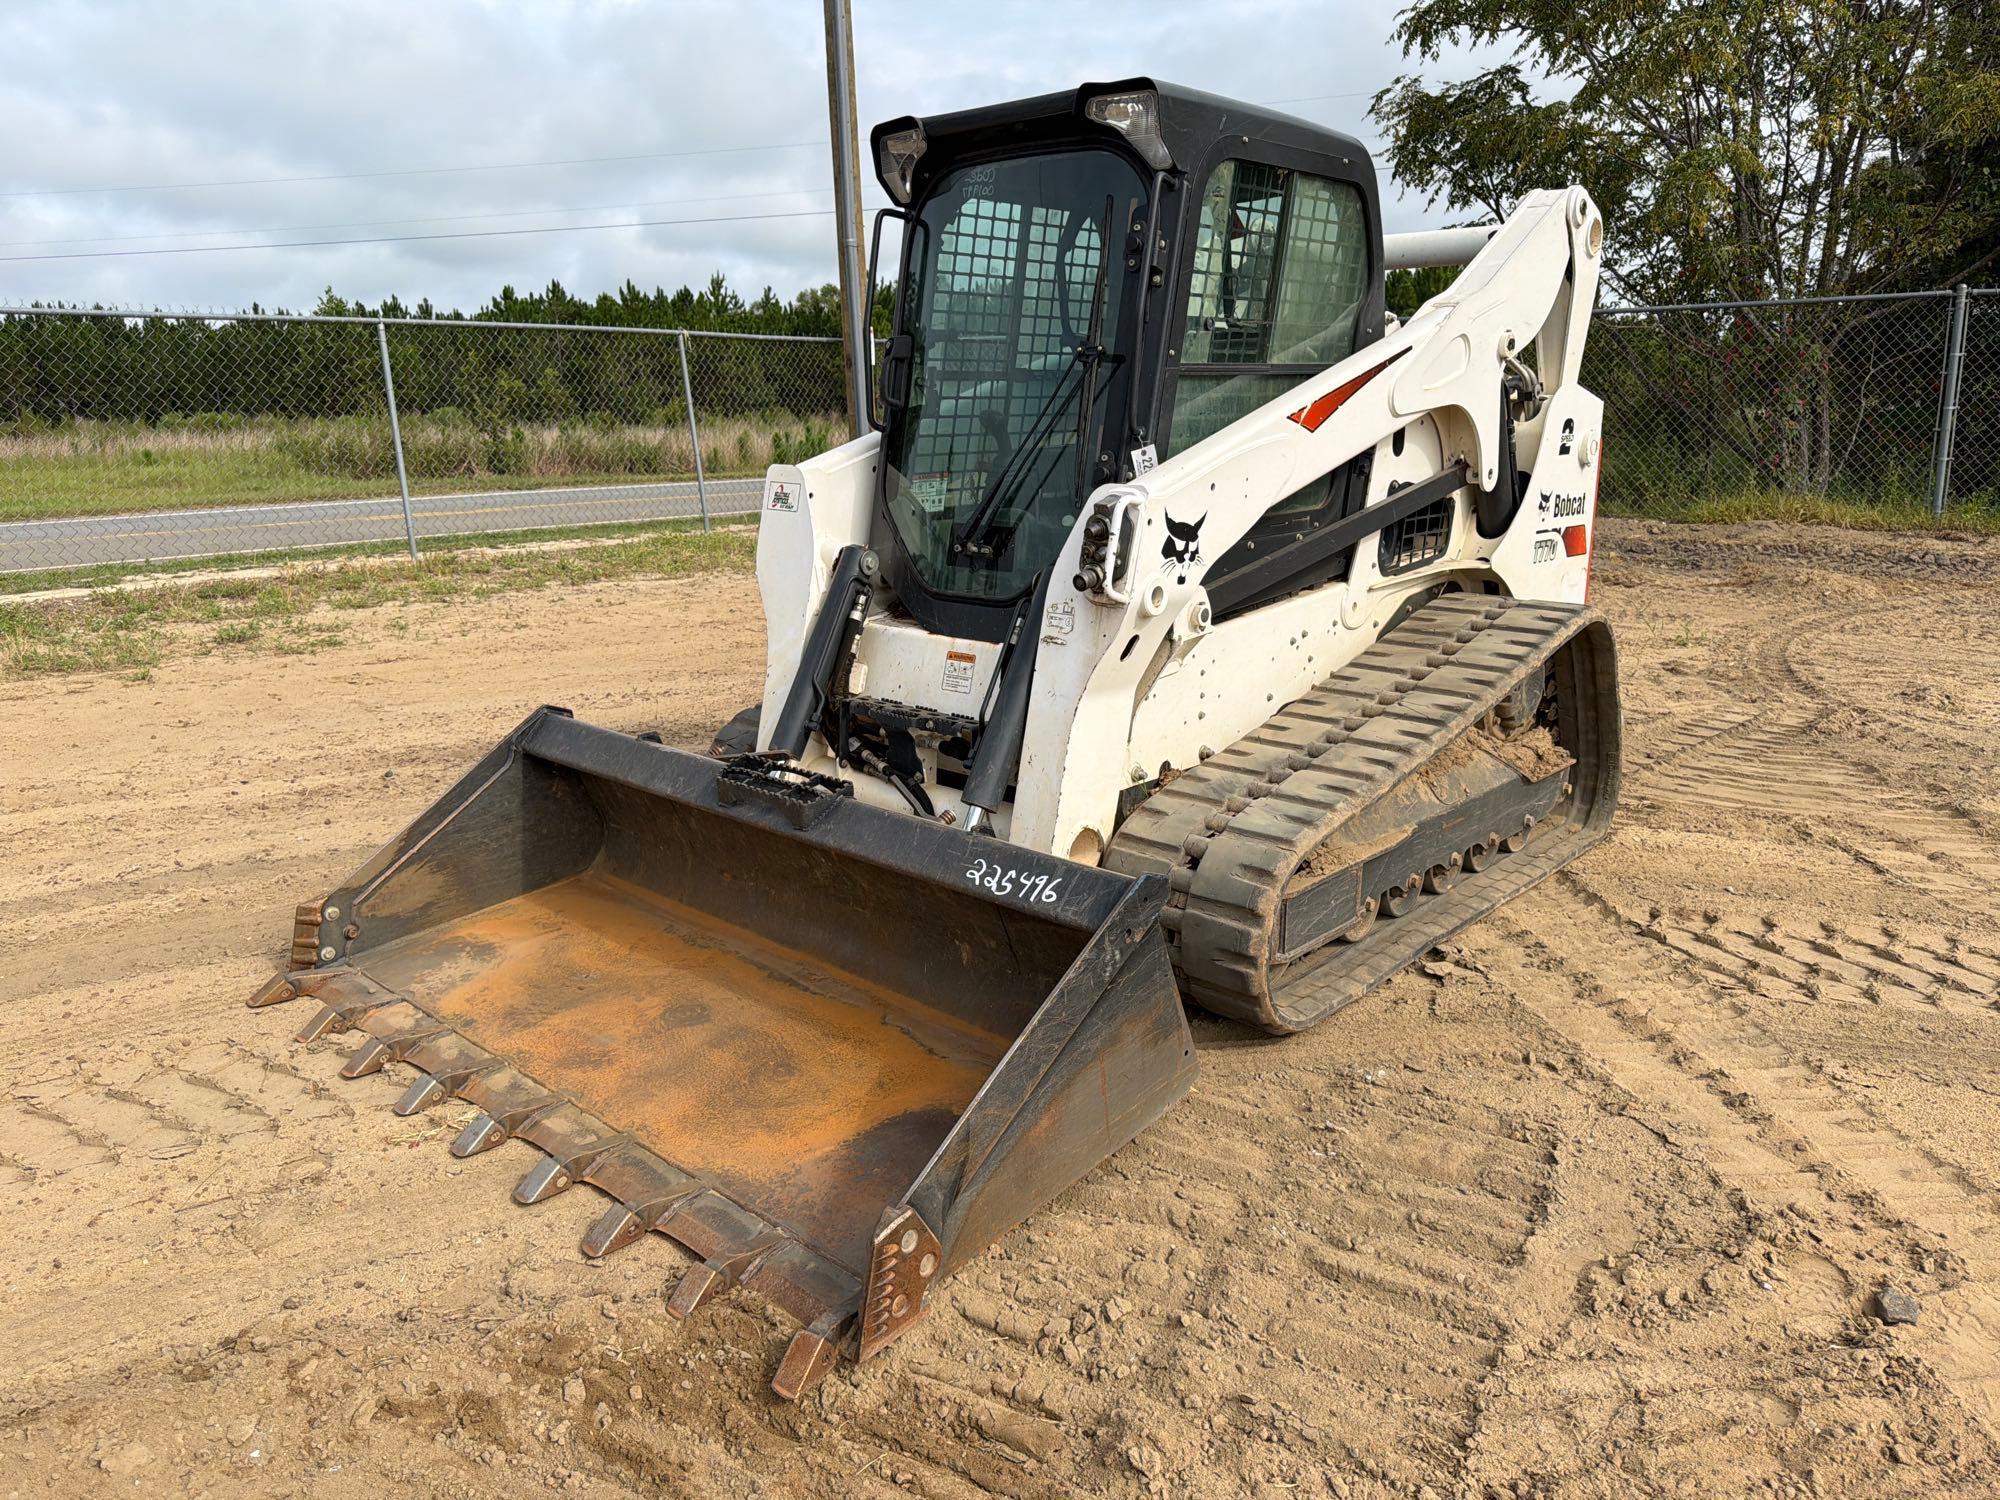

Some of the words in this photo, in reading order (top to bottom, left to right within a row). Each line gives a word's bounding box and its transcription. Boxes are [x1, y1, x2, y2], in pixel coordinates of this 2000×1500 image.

[1561, 434, 1575, 443] SPEED
[1553, 492, 1586, 518] Bobcat
[1533, 539, 1558, 564] T770
[966, 858, 1063, 903] 225496
